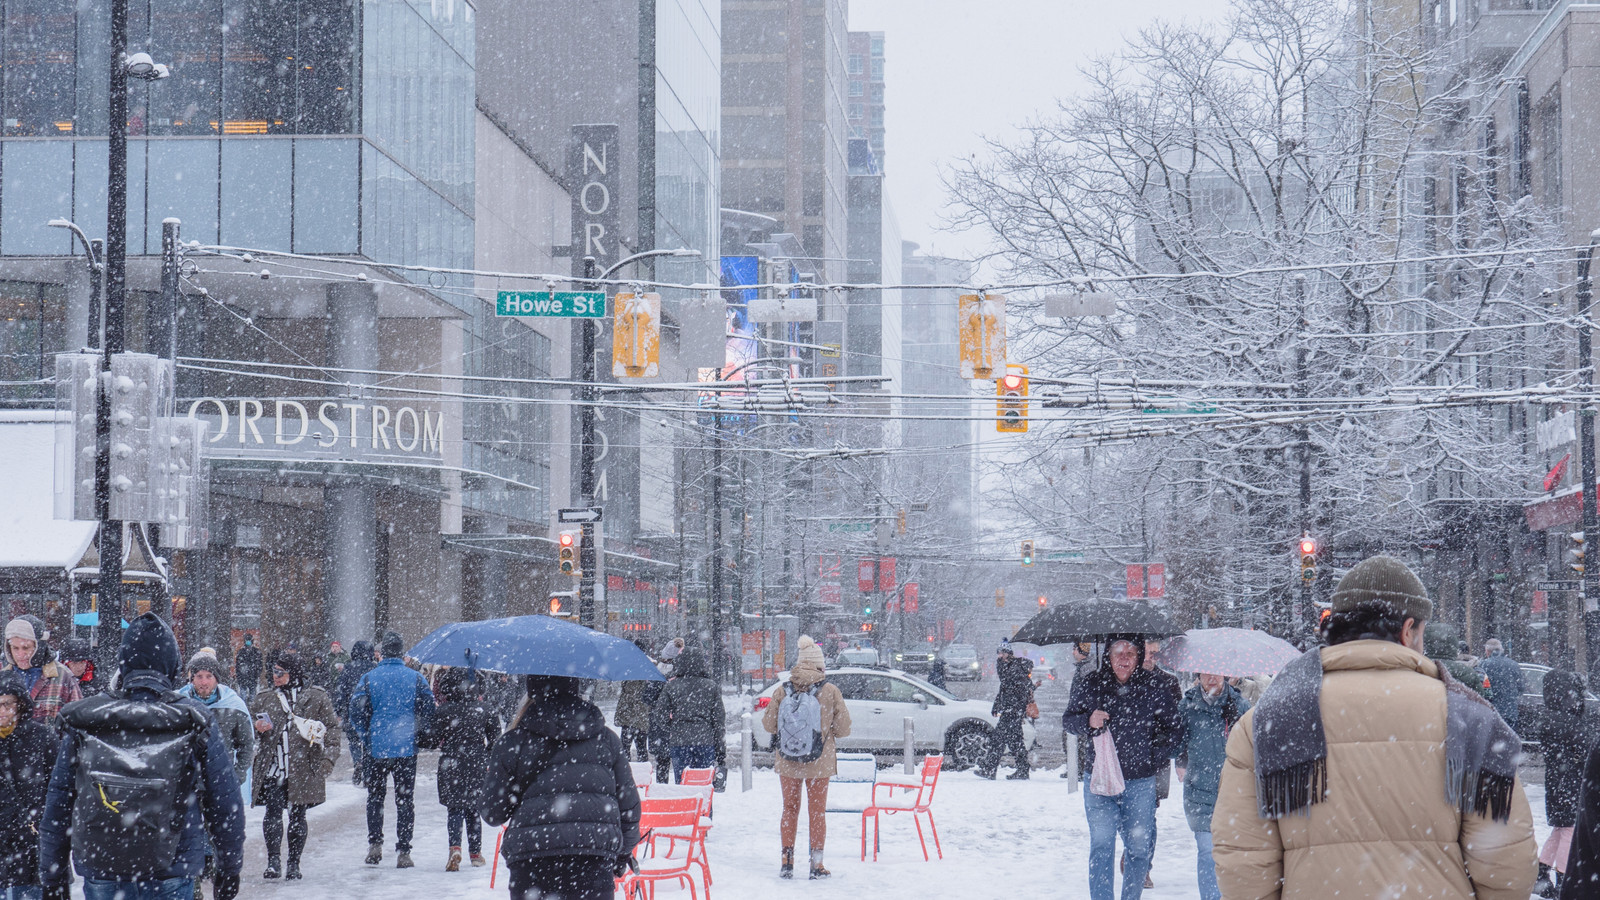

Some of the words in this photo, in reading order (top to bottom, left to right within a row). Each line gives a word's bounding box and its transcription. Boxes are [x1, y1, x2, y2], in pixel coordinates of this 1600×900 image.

[505, 295, 563, 313] Howe
[573, 296, 596, 314] St
[174, 399, 443, 453] ORDSTROM
